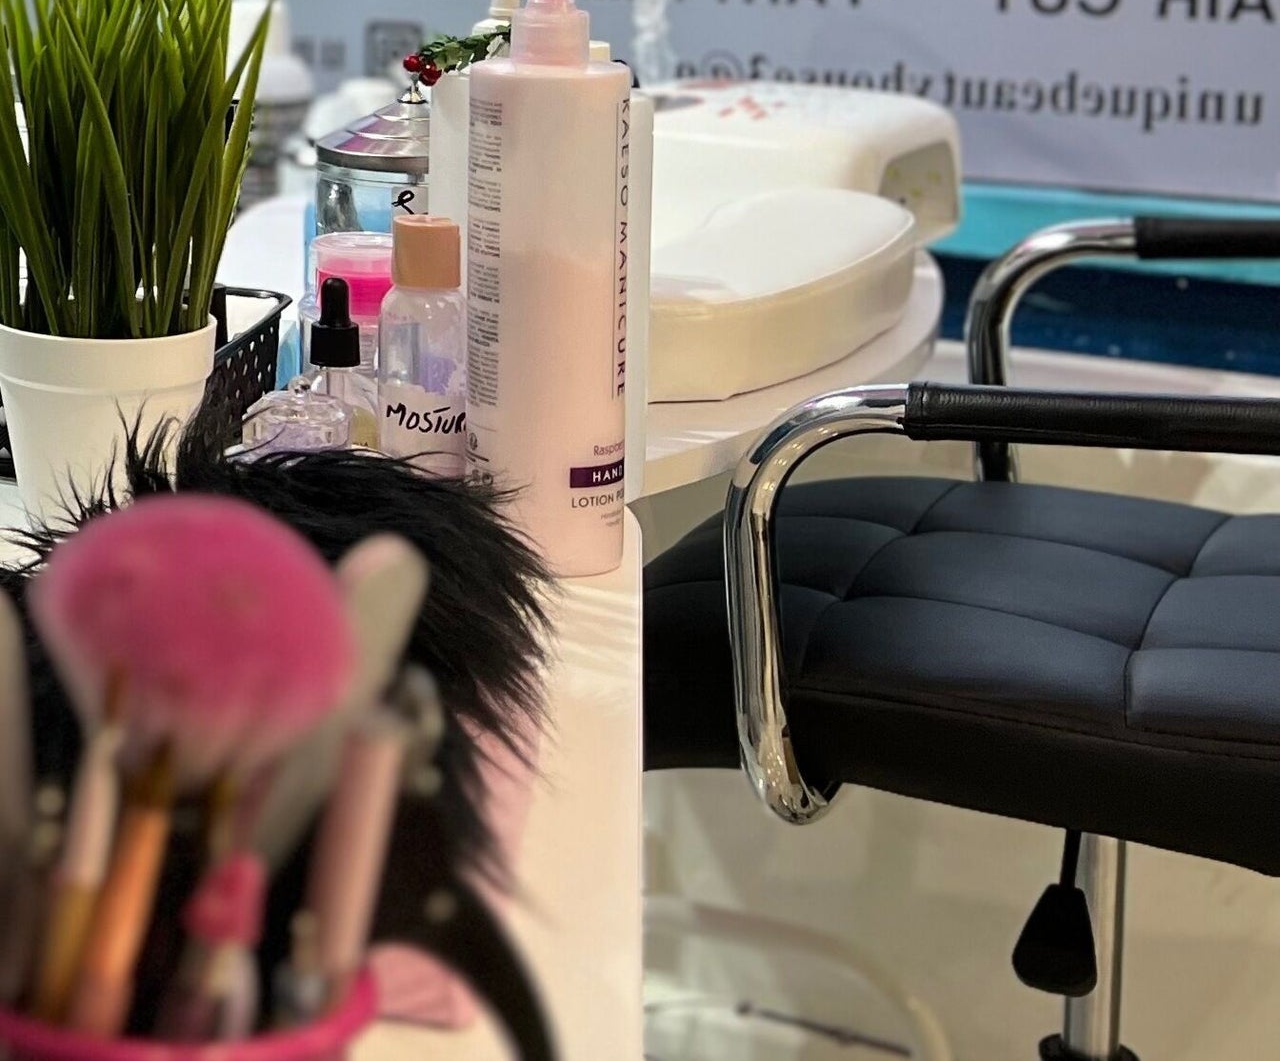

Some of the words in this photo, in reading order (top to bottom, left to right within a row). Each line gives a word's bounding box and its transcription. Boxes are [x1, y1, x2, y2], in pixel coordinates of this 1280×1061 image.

[619, 98, 631, 207] KAESO
[616, 220, 628, 398] MANICURE
[571, 493, 614, 509] LOTION
